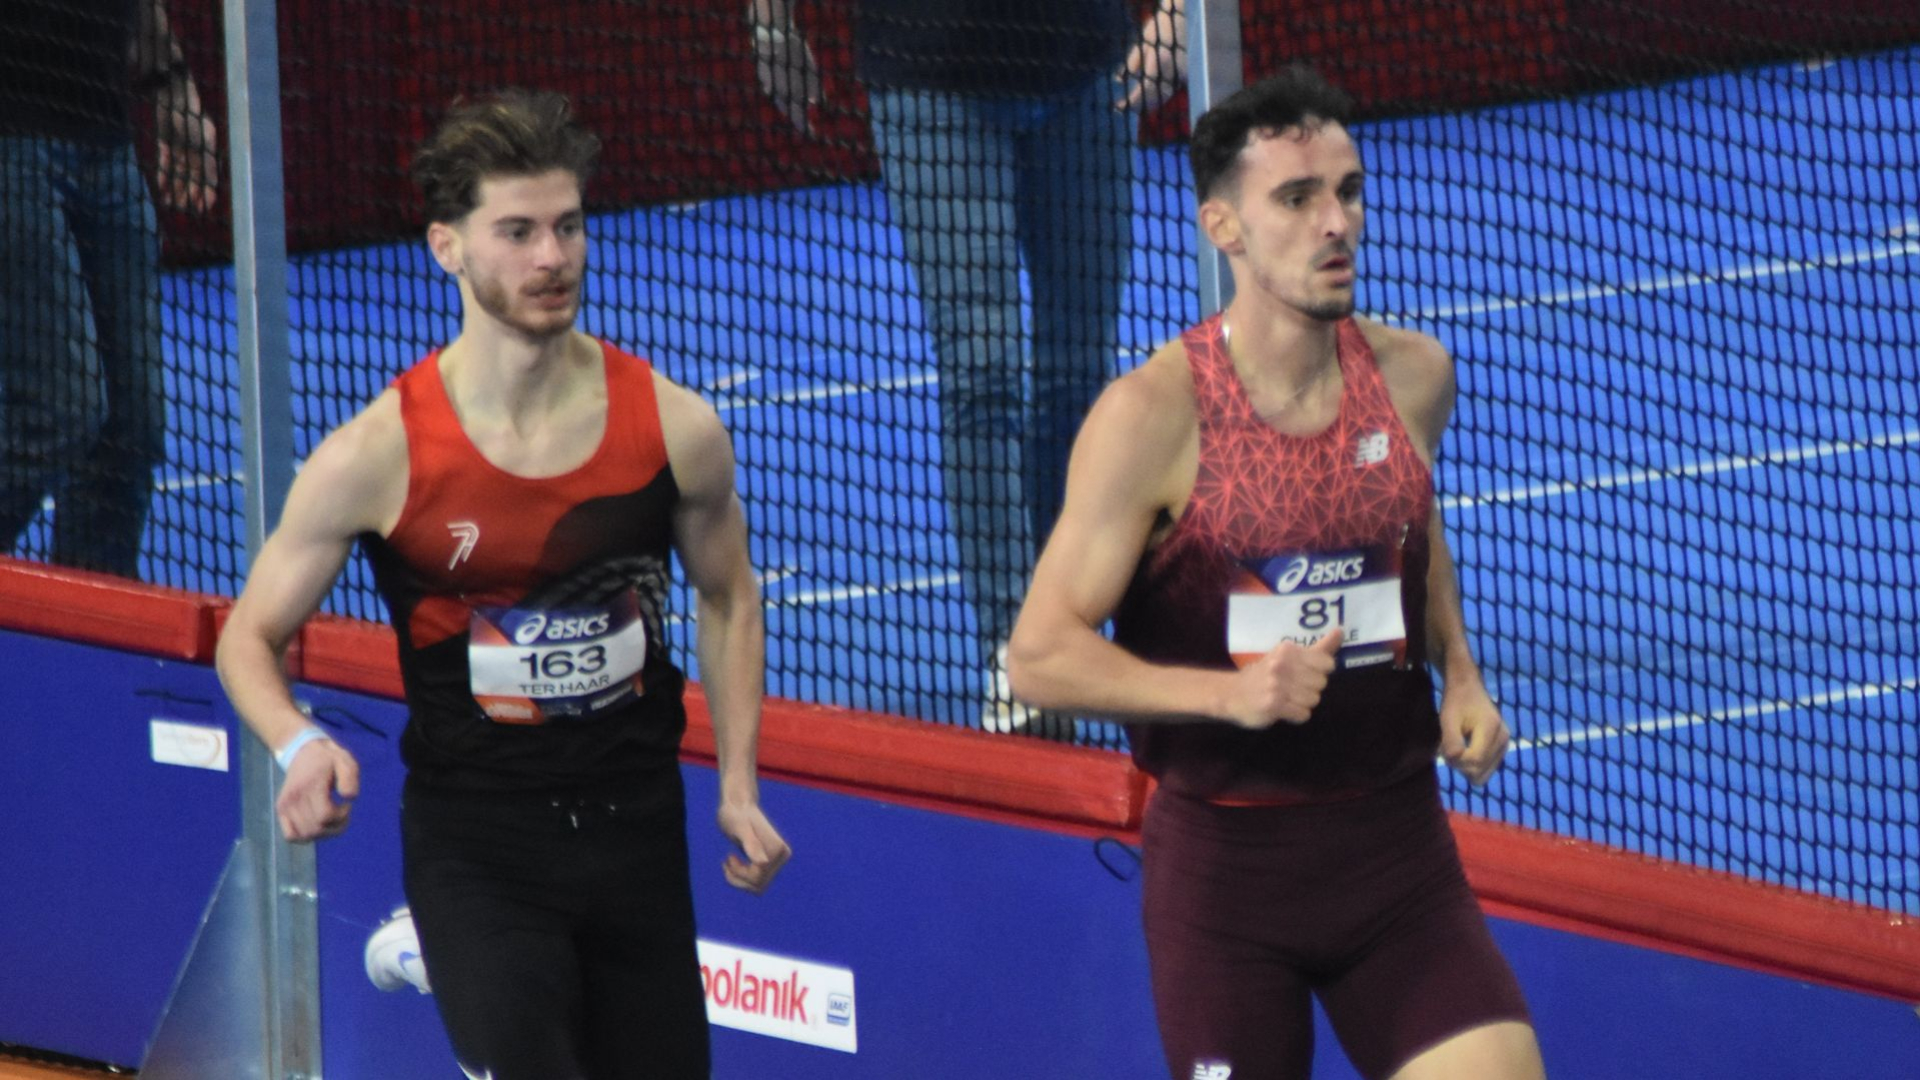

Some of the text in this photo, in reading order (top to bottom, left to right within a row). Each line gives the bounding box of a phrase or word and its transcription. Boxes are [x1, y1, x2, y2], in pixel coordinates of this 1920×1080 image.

[1308, 557, 1364, 585] asics
[1299, 593, 1345, 629] 81
[546, 613, 609, 639] asics
[520, 645, 607, 680] 163
[518, 674, 610, 695] TER HAAR
